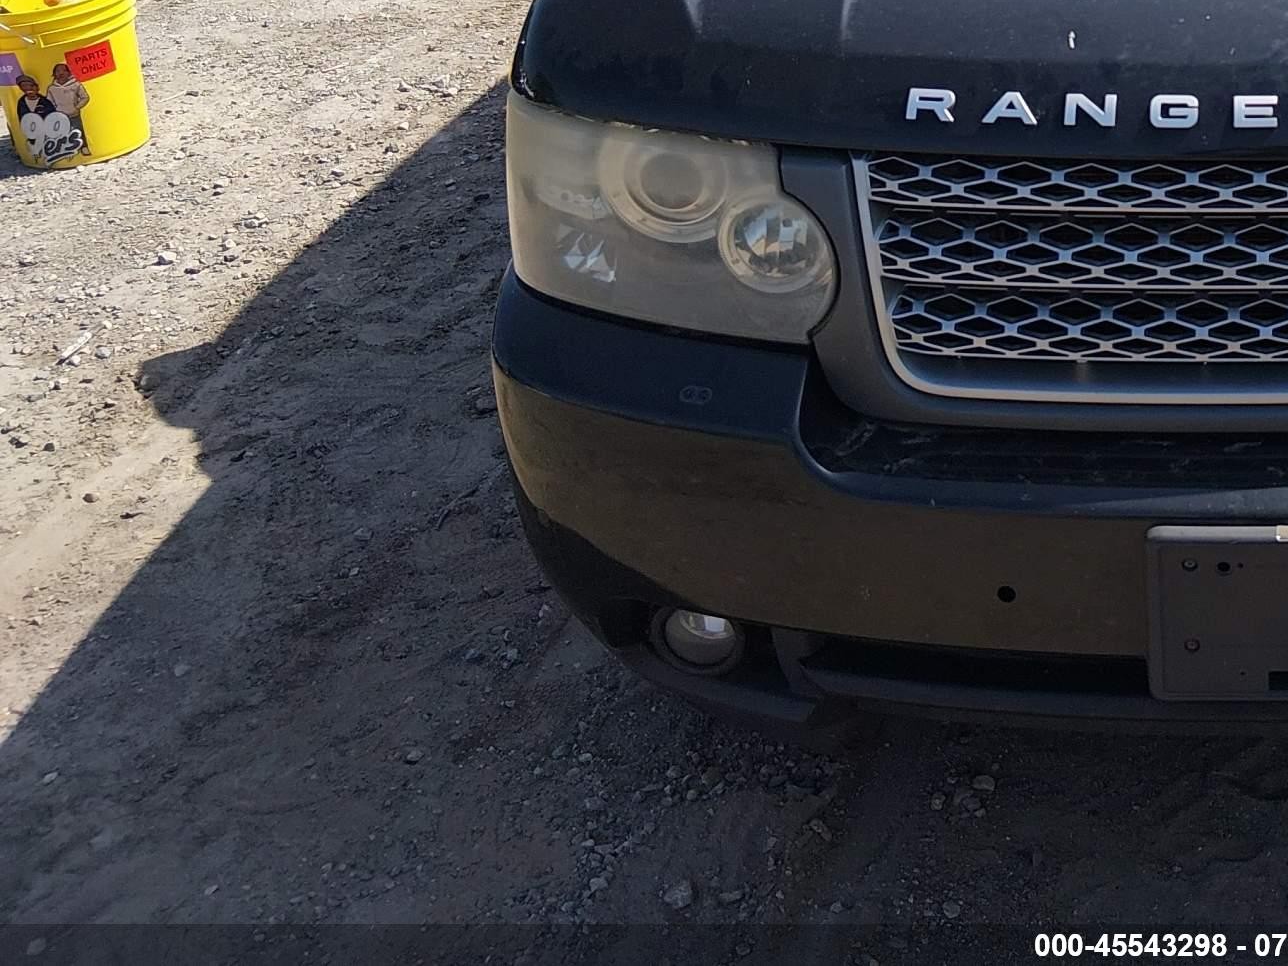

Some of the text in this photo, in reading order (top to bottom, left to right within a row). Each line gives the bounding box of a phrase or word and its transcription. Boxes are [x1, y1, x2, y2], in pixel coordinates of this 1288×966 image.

[74, 48, 108, 65] PARTS
[80, 59, 108, 76] ONLY
[905, 87, 1279, 129] RANGE
